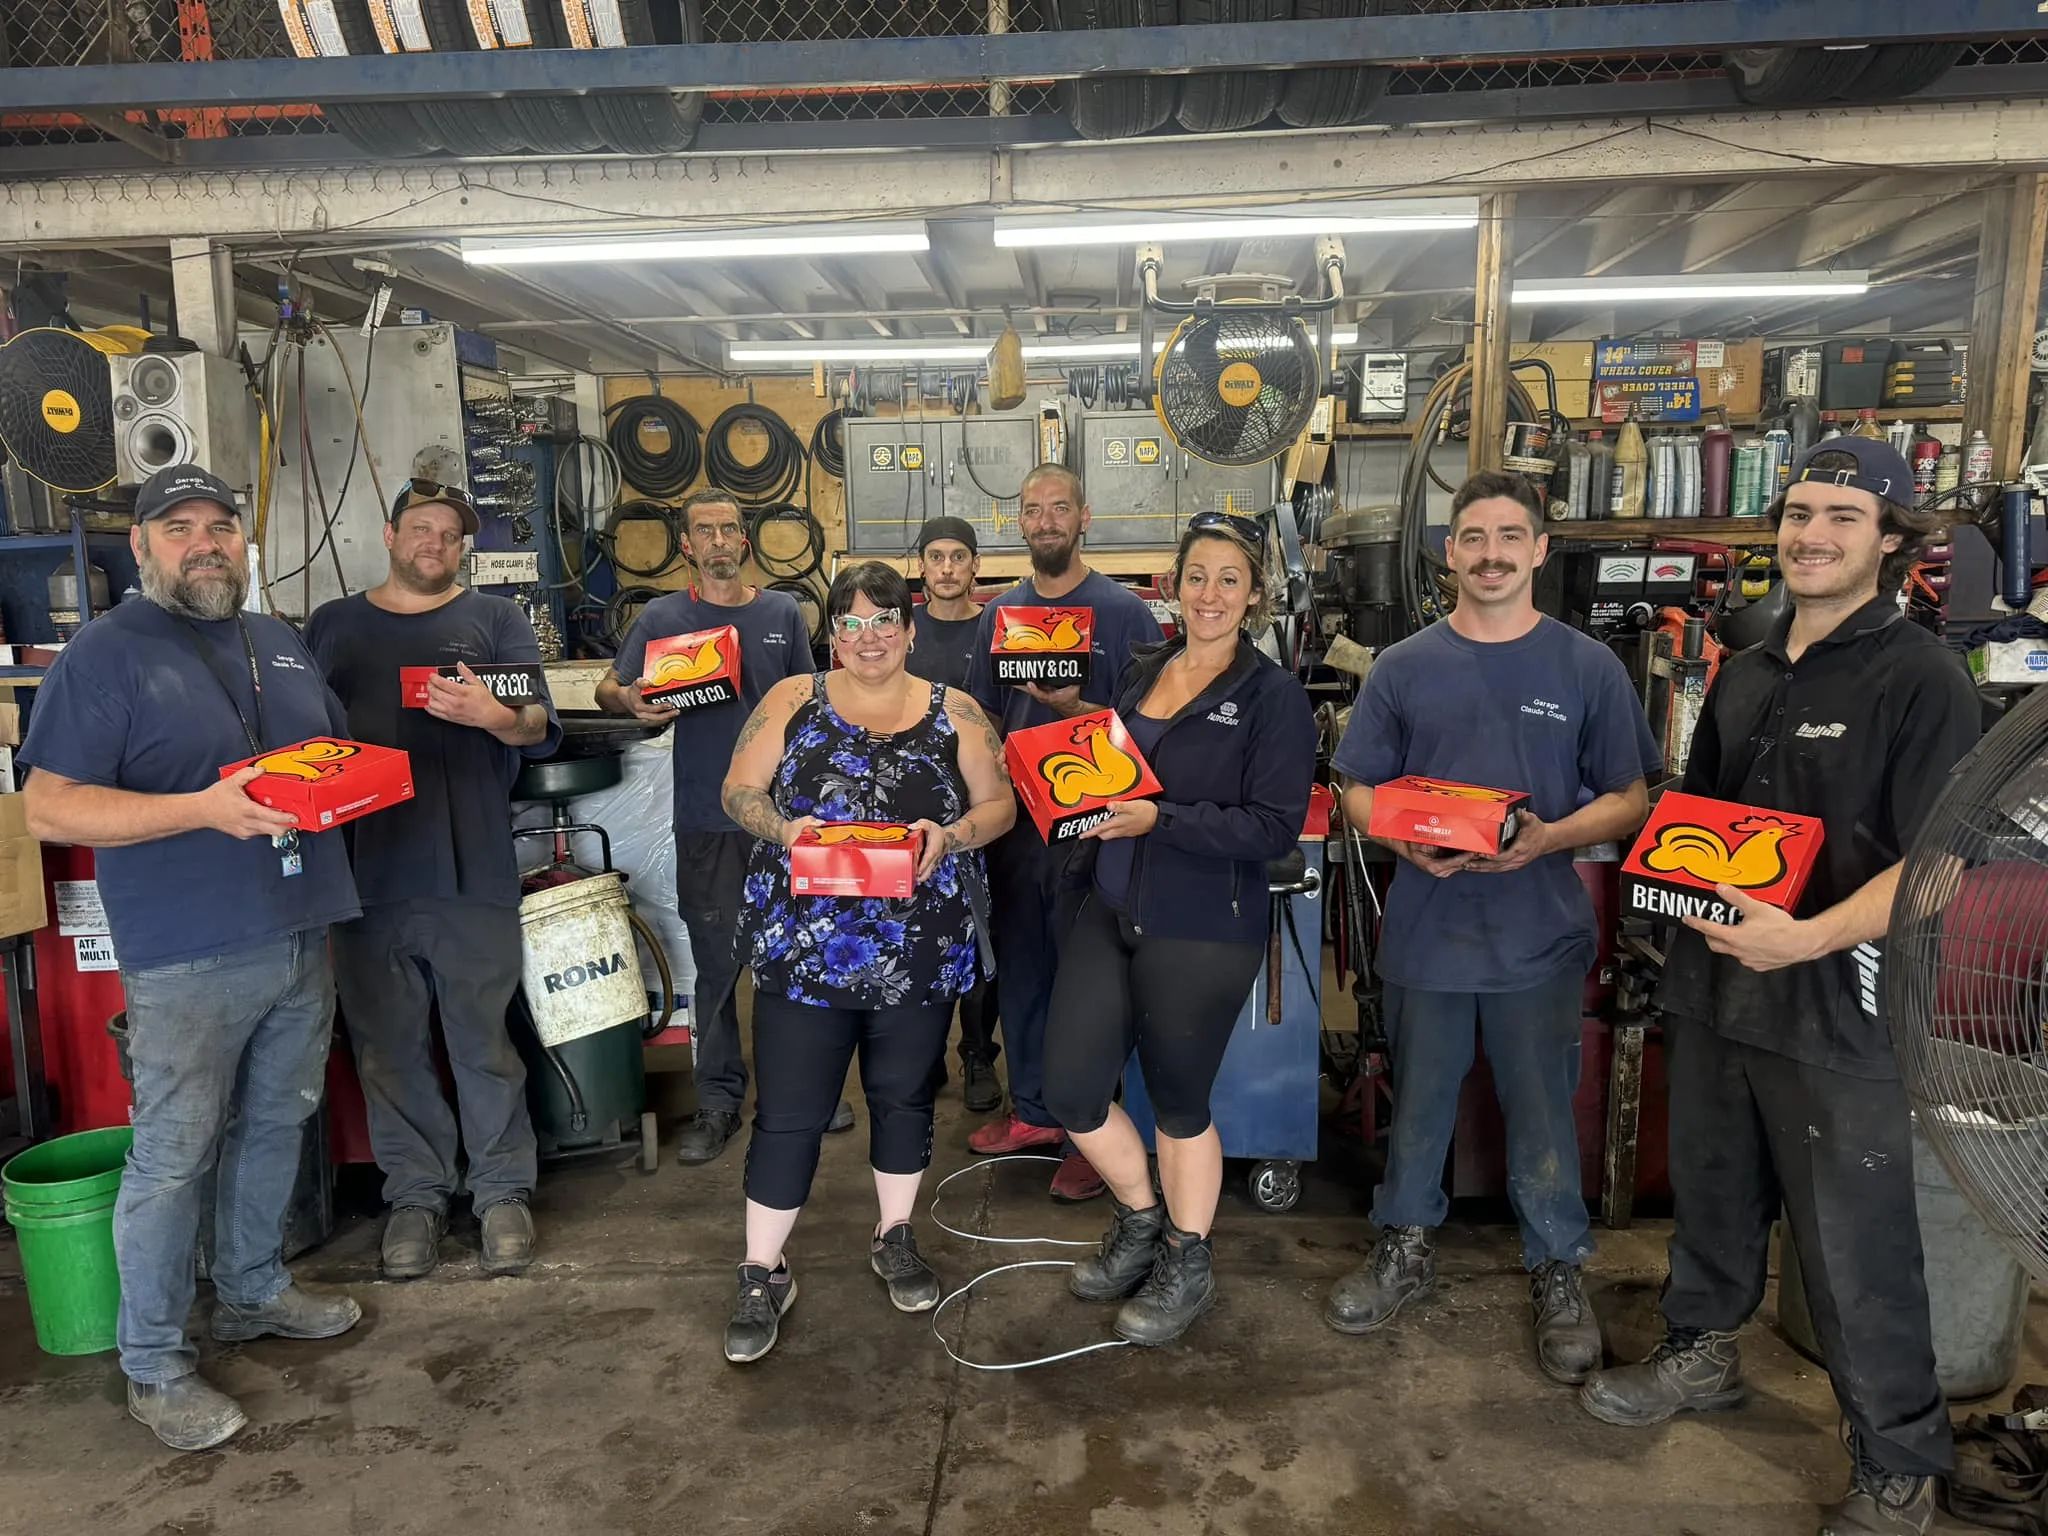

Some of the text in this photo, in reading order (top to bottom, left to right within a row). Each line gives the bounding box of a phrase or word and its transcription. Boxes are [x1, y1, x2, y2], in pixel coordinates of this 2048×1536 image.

[1605, 346, 1631, 365] 14"
[1600, 365, 1673, 377] WHEEL COVER
[1622, 381, 1695, 391] WHEEL COVER
[1139, 446, 1155, 457] NAPA
[490, 559, 524, 569] HOSE CLAMPS
[2029, 655, 2048, 665] NAPA
[999, 659, 1083, 679] BENNY&CO.
[1533, 698, 1560, 710] Garage
[1520, 705, 1545, 716] Claude
[1206, 712, 1241, 726] AUTOCAR
[79, 939, 97, 950] ATF
[80, 950, 111, 961] MULTI
[543, 951, 629, 995] RONA
